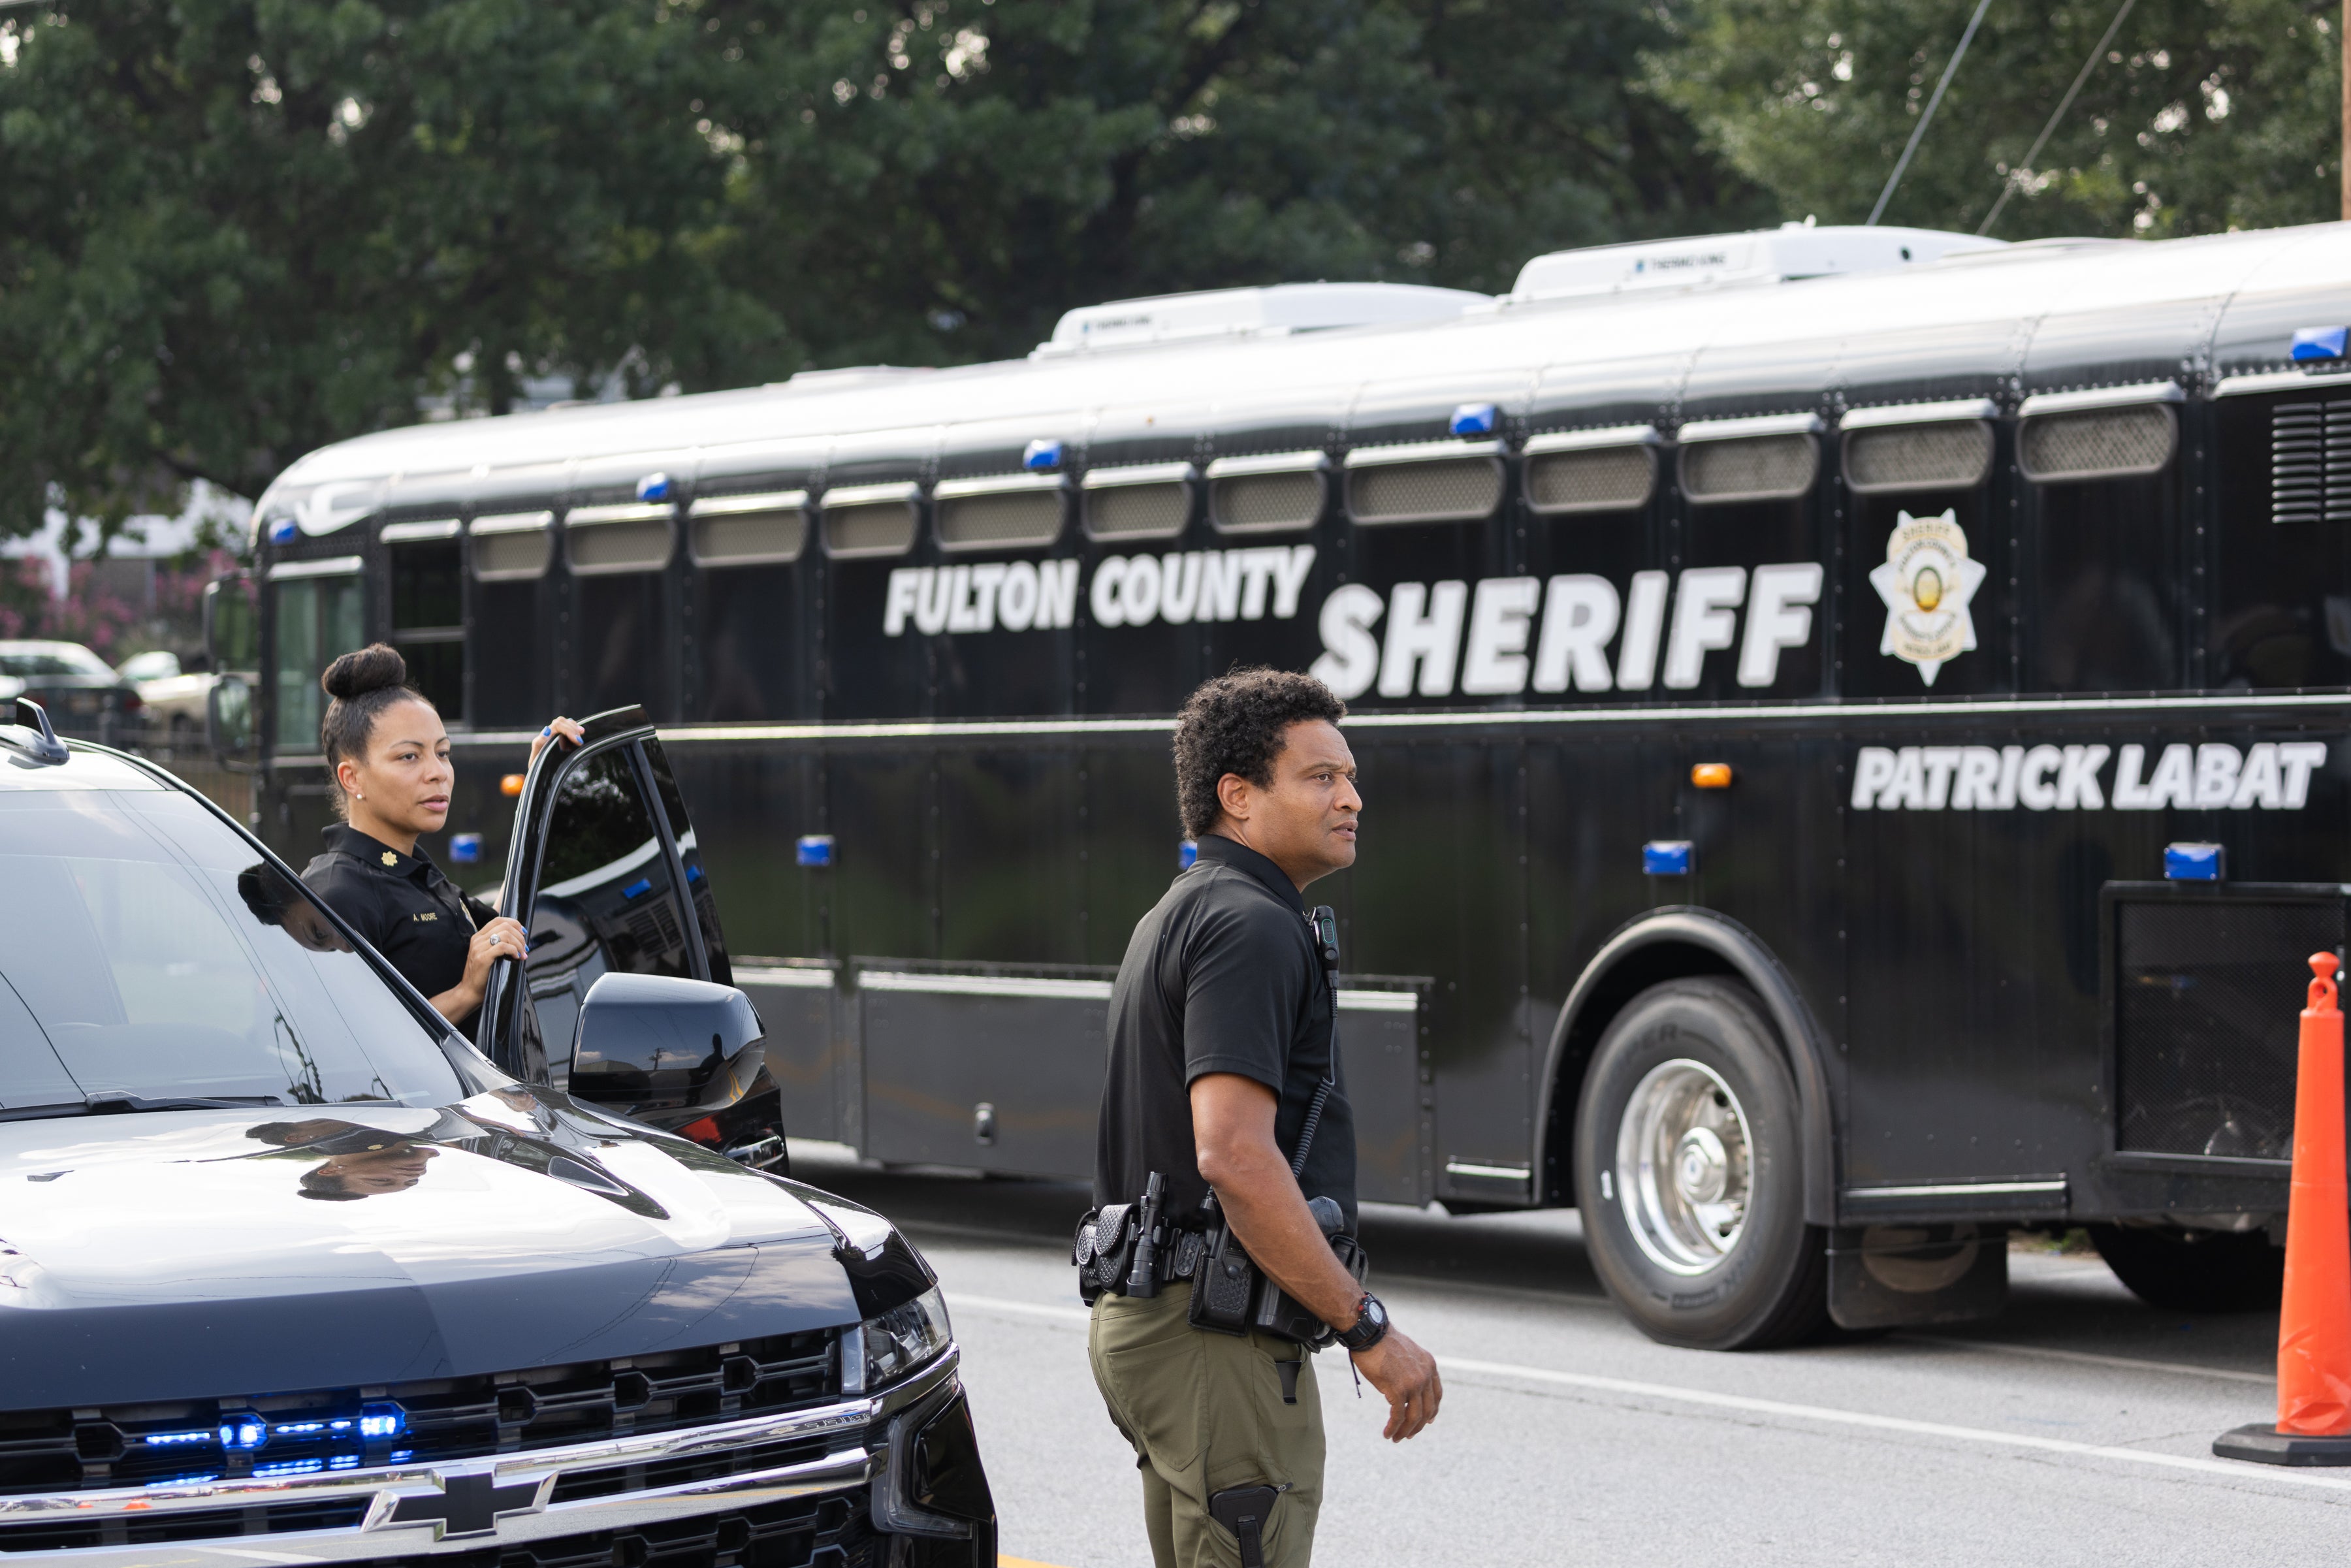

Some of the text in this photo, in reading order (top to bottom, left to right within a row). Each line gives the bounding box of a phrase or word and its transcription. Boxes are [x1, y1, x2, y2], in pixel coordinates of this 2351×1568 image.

[884, 545, 1315, 637] FULTON COUNTY
[1309, 562, 1823, 700] SHERIFF
[1851, 742, 2327, 810] PATRICK LABAT
[413, 912, 438, 921] A. MOORE
